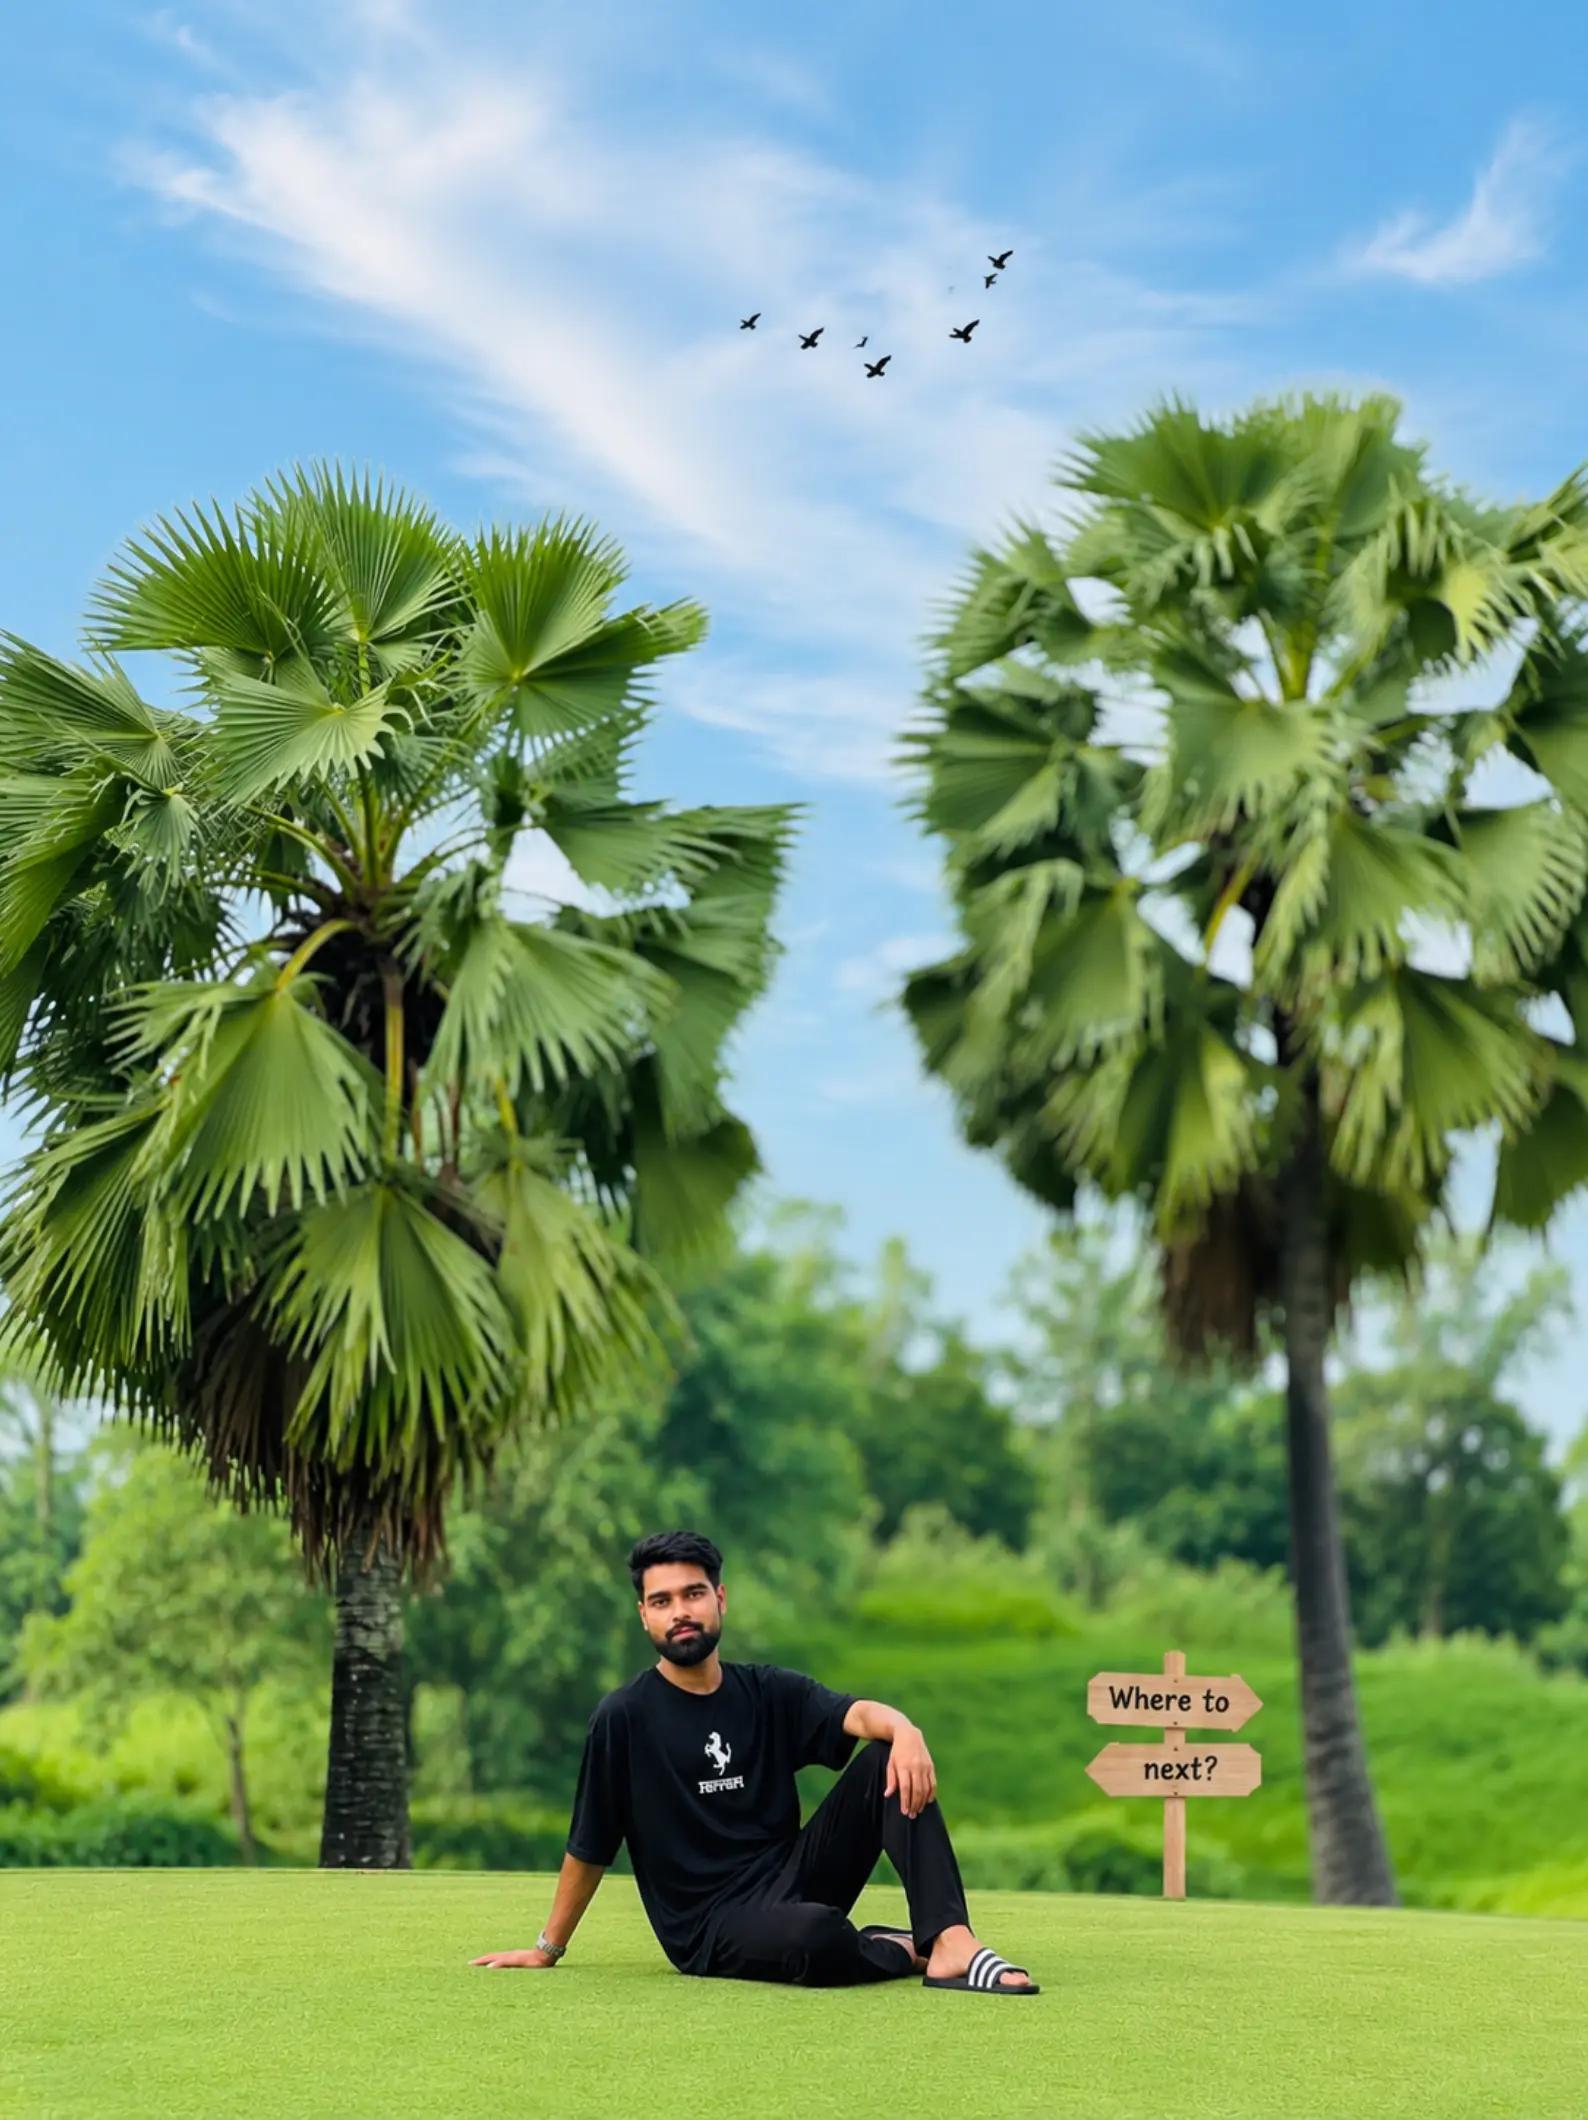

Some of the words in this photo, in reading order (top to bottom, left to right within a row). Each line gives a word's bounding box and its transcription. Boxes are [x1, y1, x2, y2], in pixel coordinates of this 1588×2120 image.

[1108, 1686, 1192, 1711] Where
[1202, 1688, 1230, 1713] to
[1144, 1755, 1218, 1781] next?
